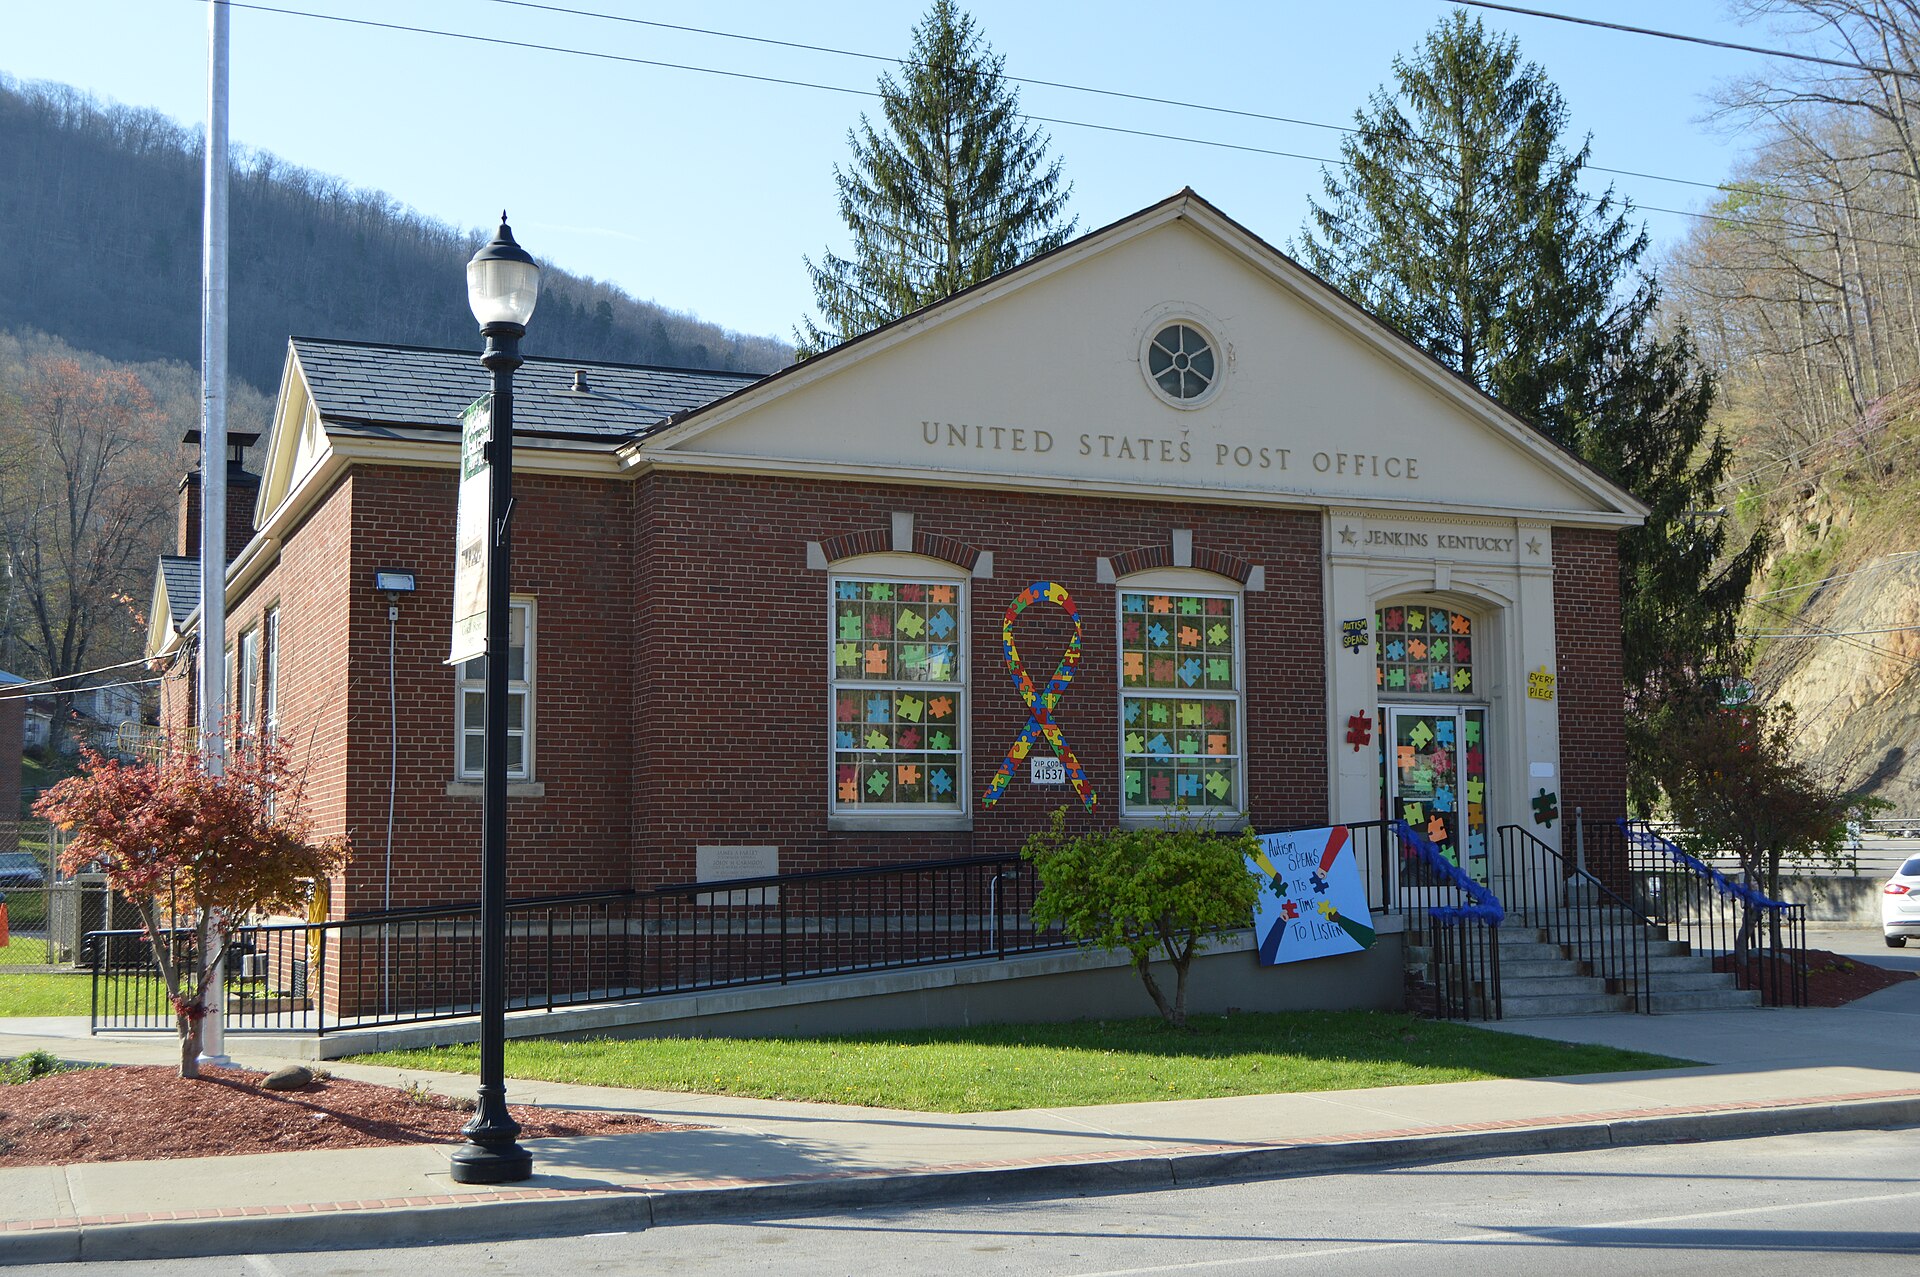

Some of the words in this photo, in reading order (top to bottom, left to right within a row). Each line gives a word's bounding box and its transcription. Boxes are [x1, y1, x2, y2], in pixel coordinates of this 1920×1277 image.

[922, 421, 1053, 452] UNITED
[1080, 433, 1191, 463] STATES
[1216, 444, 1290, 470] POST
[1313, 452, 1419, 479] OFFICE
[1365, 530, 1428, 547] JENKINS
[1438, 535, 1514, 552] KENTUCKY
[1344, 619, 1367, 631] AUTISM
[1344, 635, 1368, 647] SPEAKS
[1529, 672, 1555, 684] EVERY
[1529, 687, 1554, 700] PIECE
[1034, 769, 1063, 780] 41537
[1268, 837, 1297, 858] Autism
[1288, 848, 1320, 871] SPEAKS
[1290, 921, 1307, 941] TO
[1310, 920, 1344, 941] LISTEN
